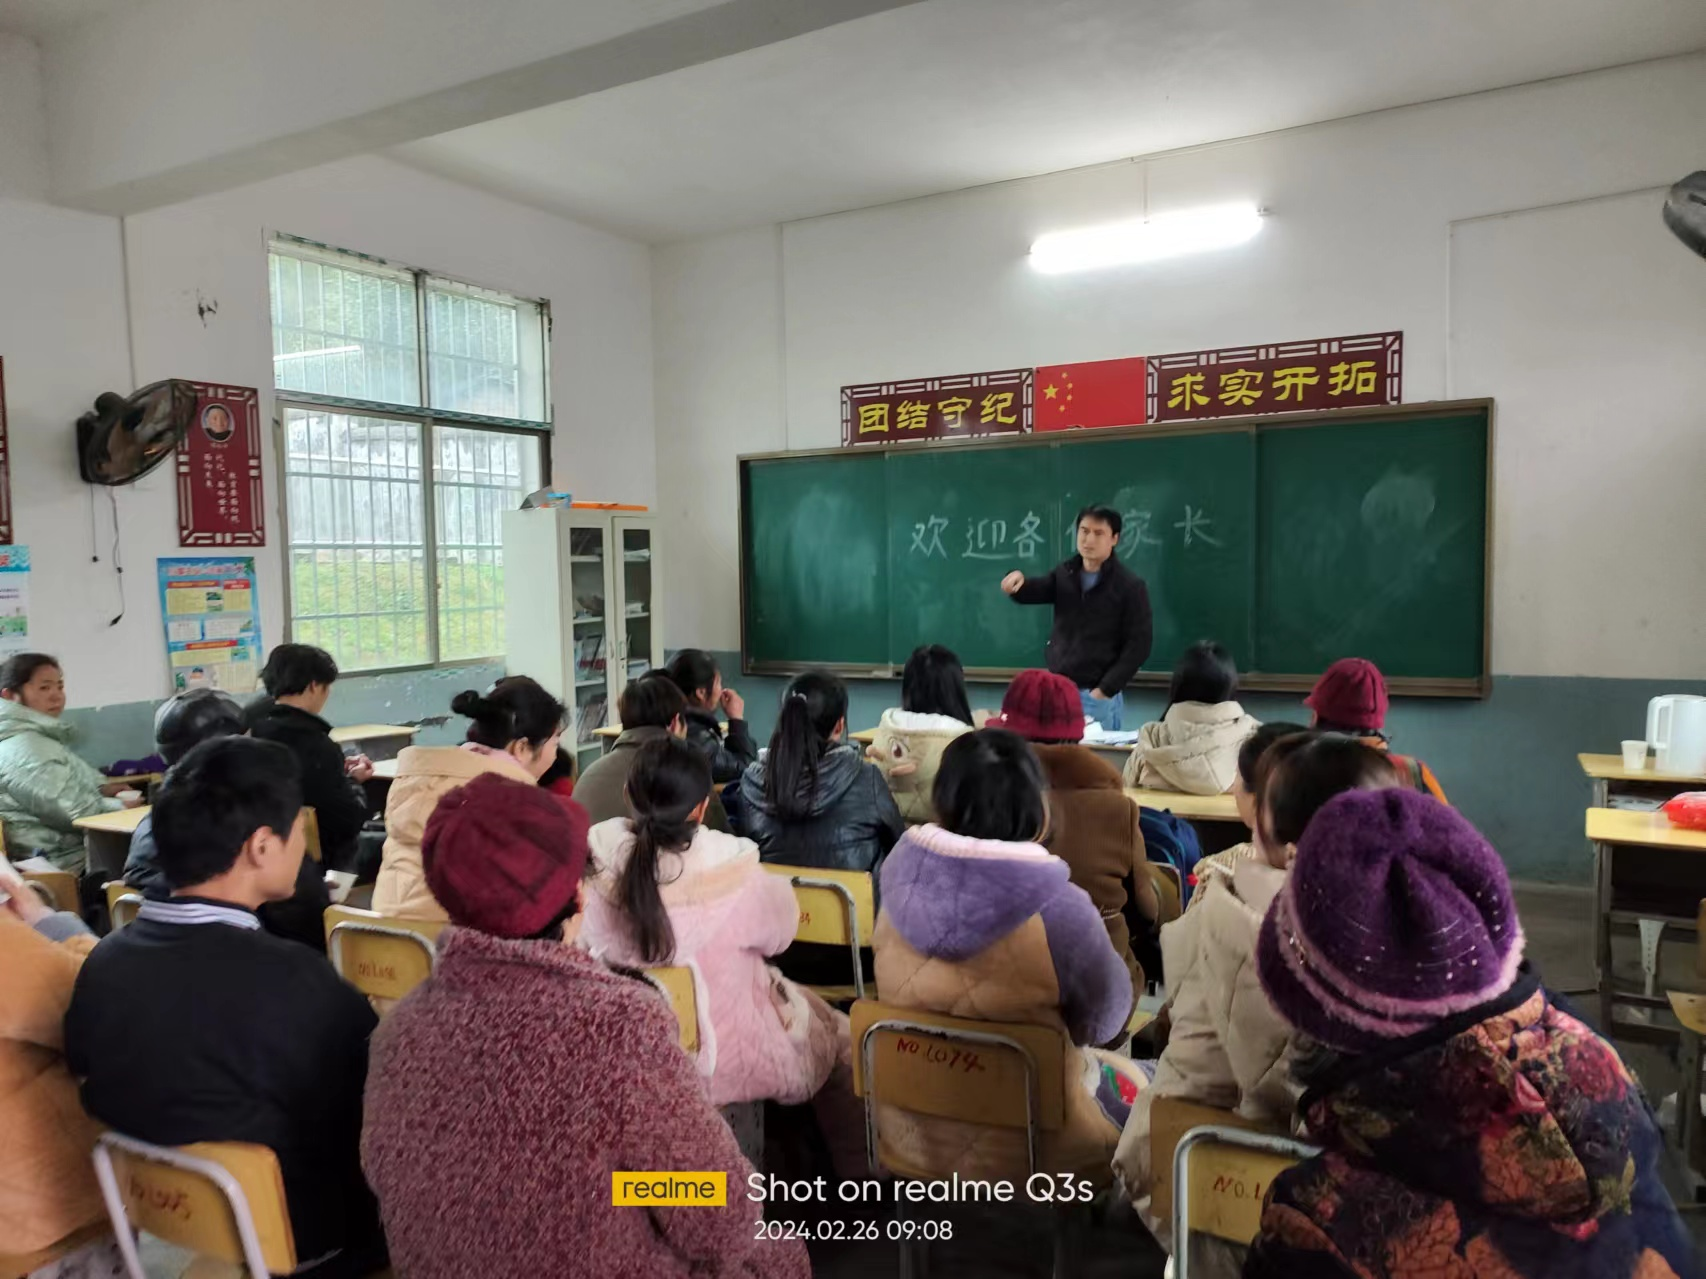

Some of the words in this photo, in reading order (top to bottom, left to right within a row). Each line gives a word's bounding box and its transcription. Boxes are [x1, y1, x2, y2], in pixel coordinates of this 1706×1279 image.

[1167, 360, 1378, 411] 求实开拓
[857, 391, 1018, 434] 团结守纪
[911, 504, 1223, 560] 欢迎各家长
